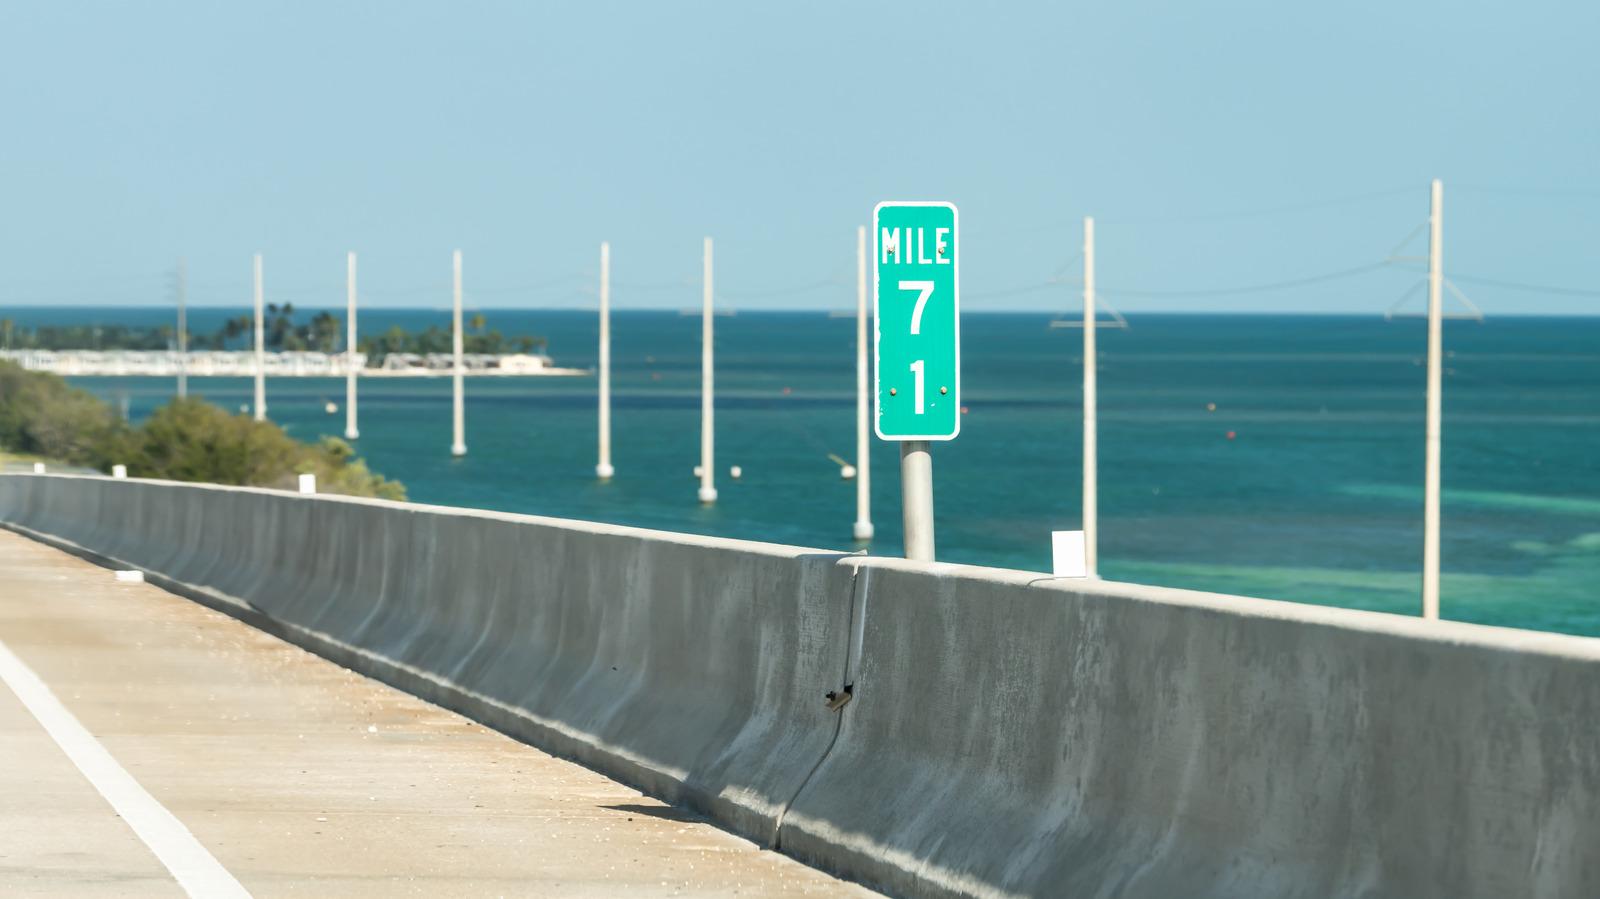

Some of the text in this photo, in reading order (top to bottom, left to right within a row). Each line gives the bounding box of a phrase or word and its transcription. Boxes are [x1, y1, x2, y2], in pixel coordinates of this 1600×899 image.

[881, 227, 950, 264] MILE
[898, 280, 935, 335] 7
[909, 359, 925, 415] 1
